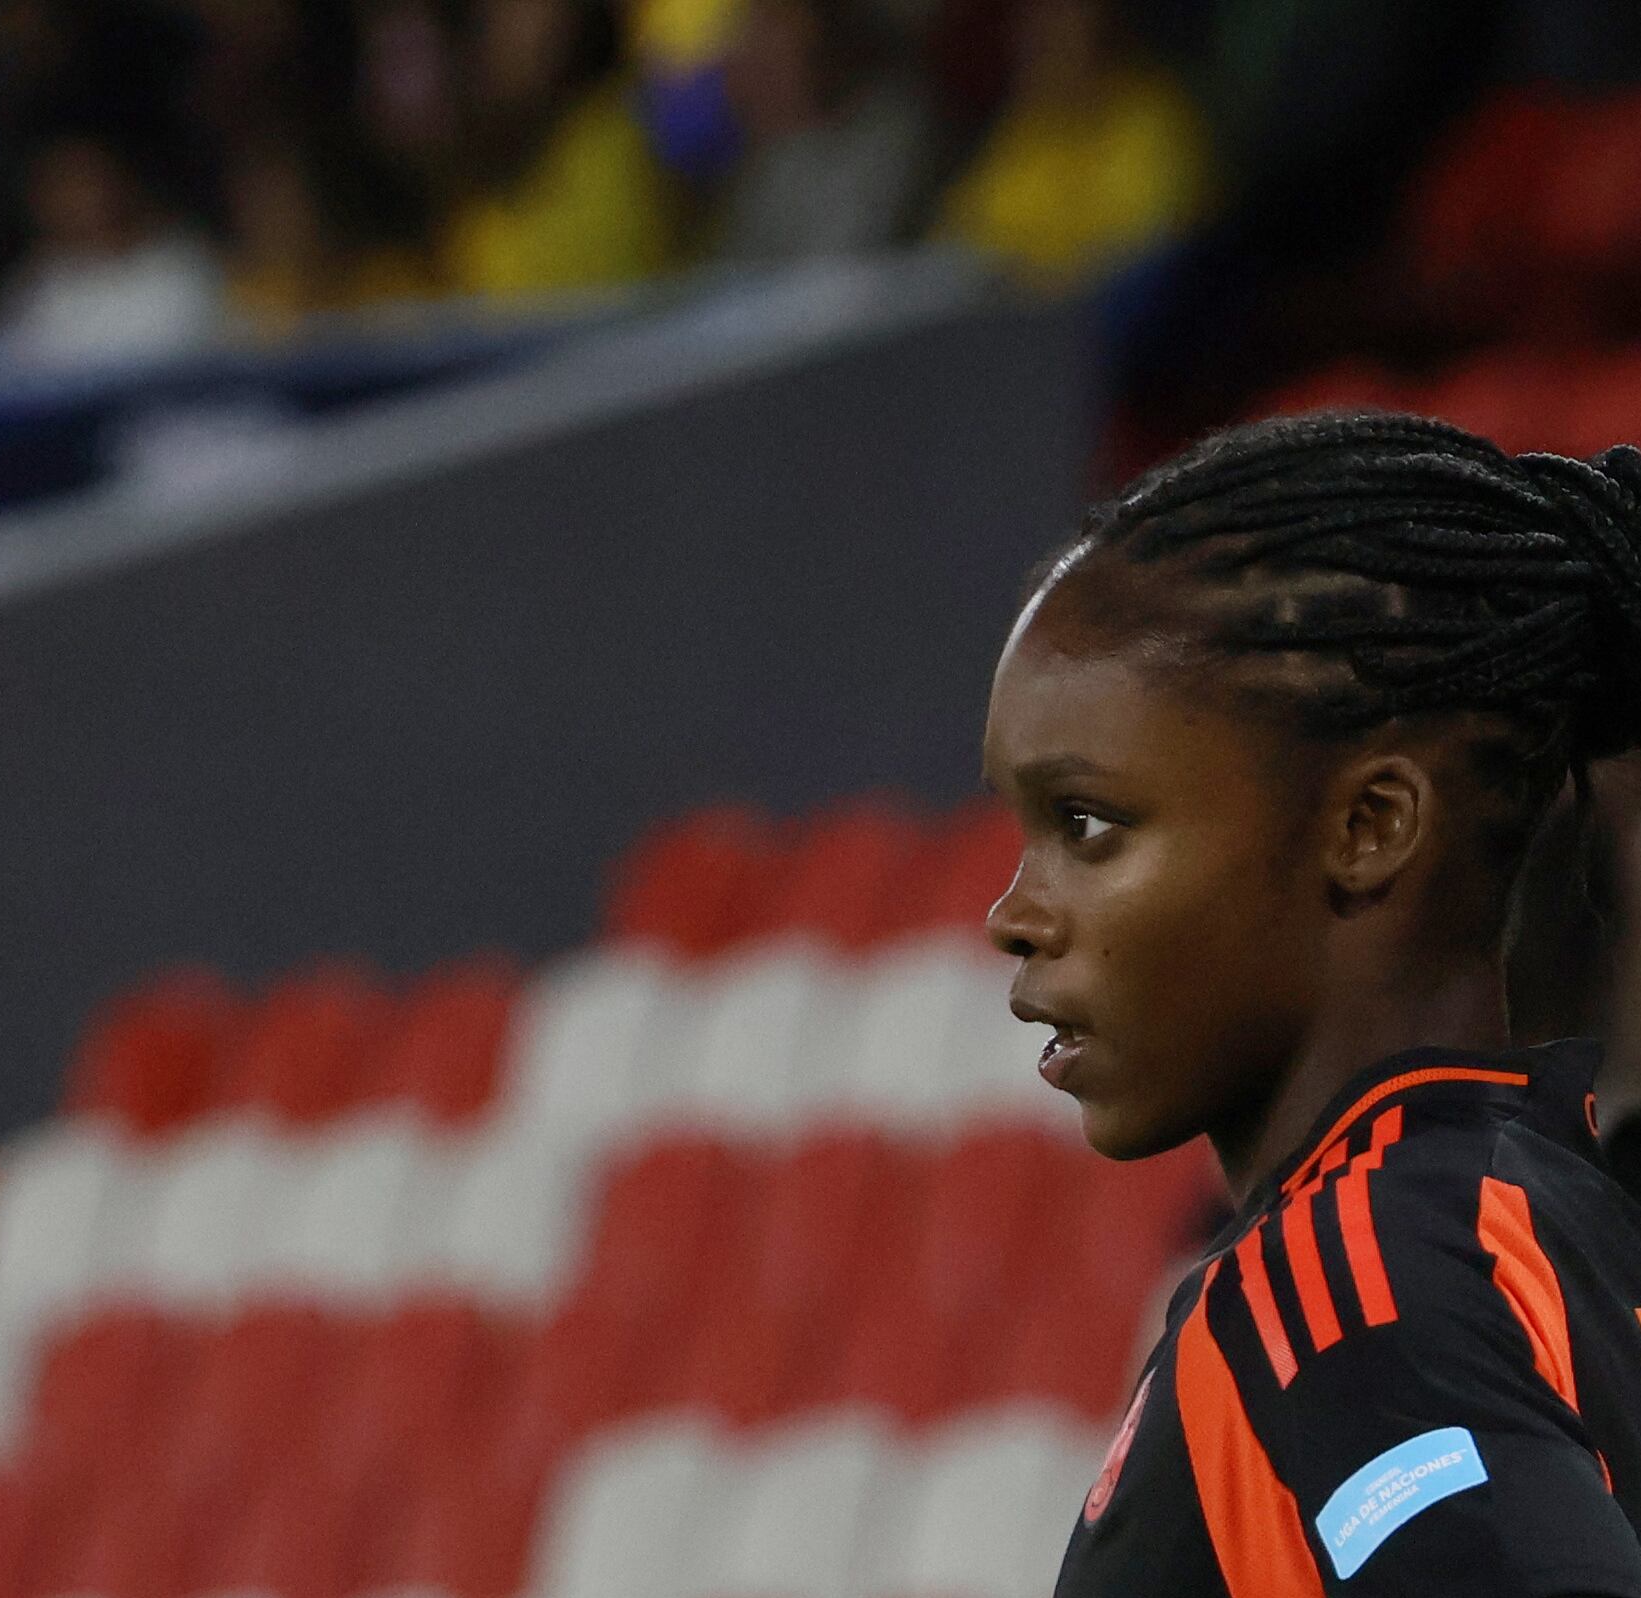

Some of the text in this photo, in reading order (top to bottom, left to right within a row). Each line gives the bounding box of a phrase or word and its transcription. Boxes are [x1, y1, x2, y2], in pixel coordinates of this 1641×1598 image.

[1333, 1516, 1361, 1548] LIGA
[1360, 1497, 1380, 1520] DE
[1379, 1451, 1463, 1501] NACIONES
